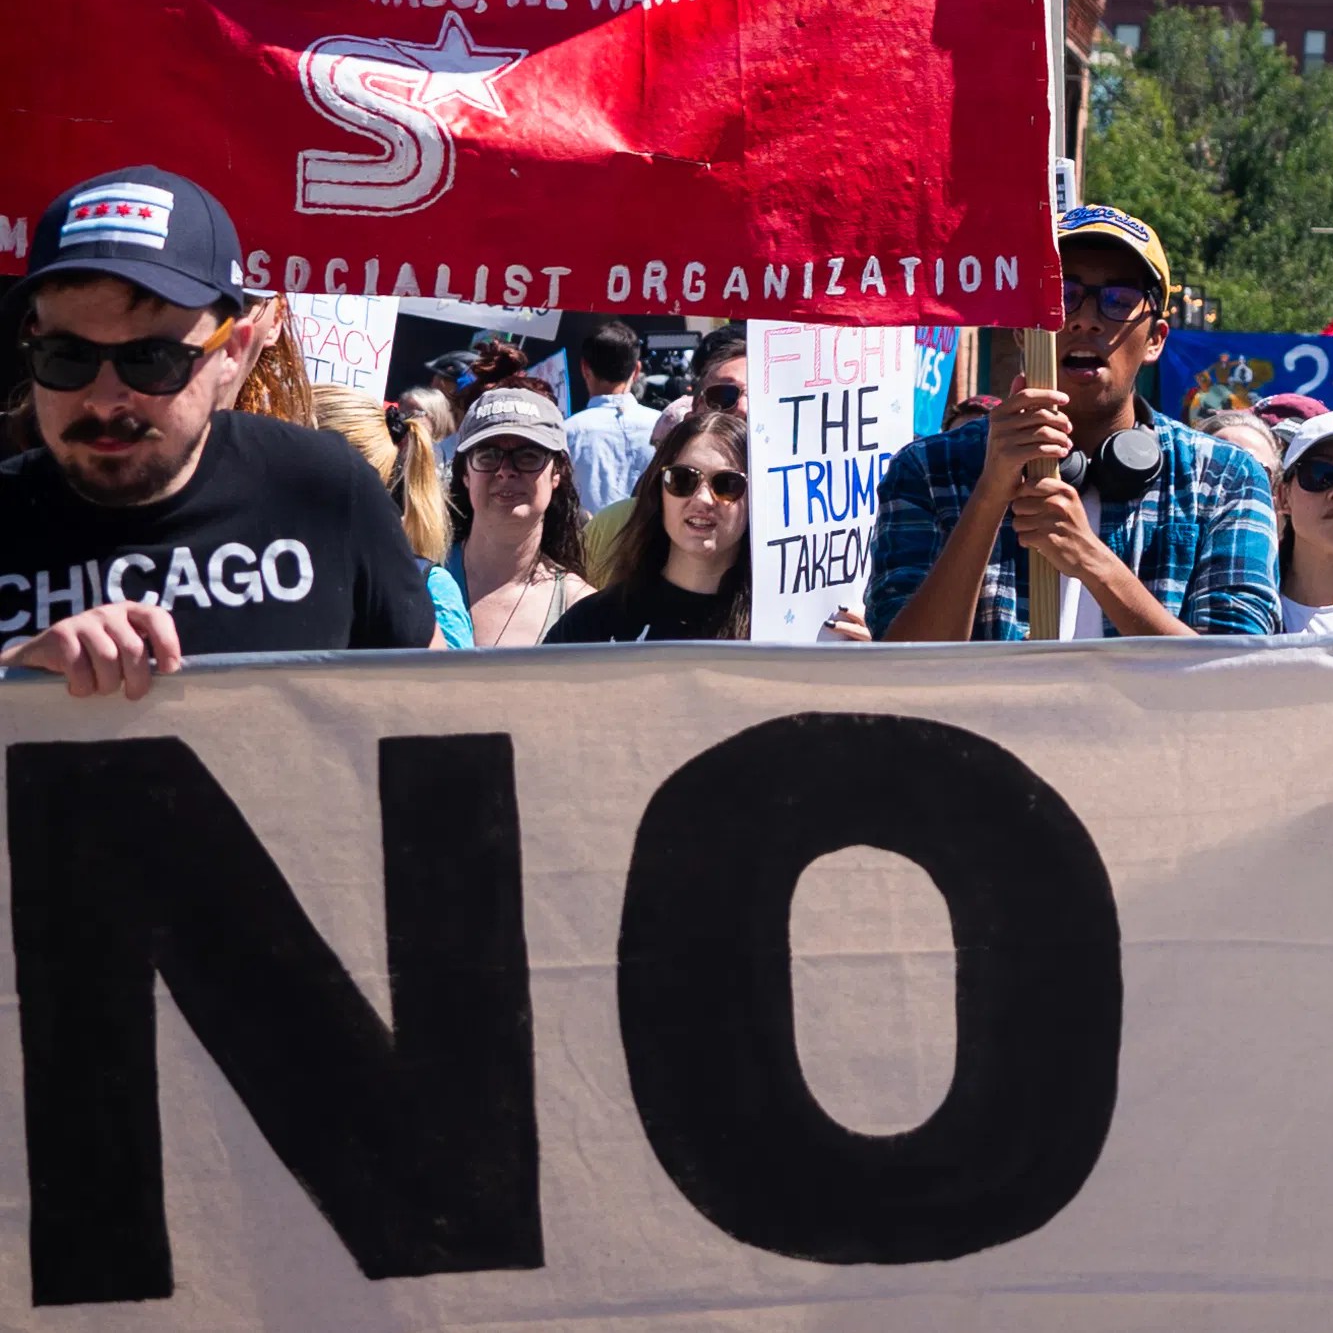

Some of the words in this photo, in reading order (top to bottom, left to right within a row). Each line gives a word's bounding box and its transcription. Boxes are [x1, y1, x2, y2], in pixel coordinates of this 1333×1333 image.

[244, 249, 572, 307] SOCIALIST
[607, 252, 1019, 304] ORGANIZATION
[779, 386, 879, 455] THE
[0, 538, 314, 632] CHICAGO
[6, 710, 1123, 1307] NO
